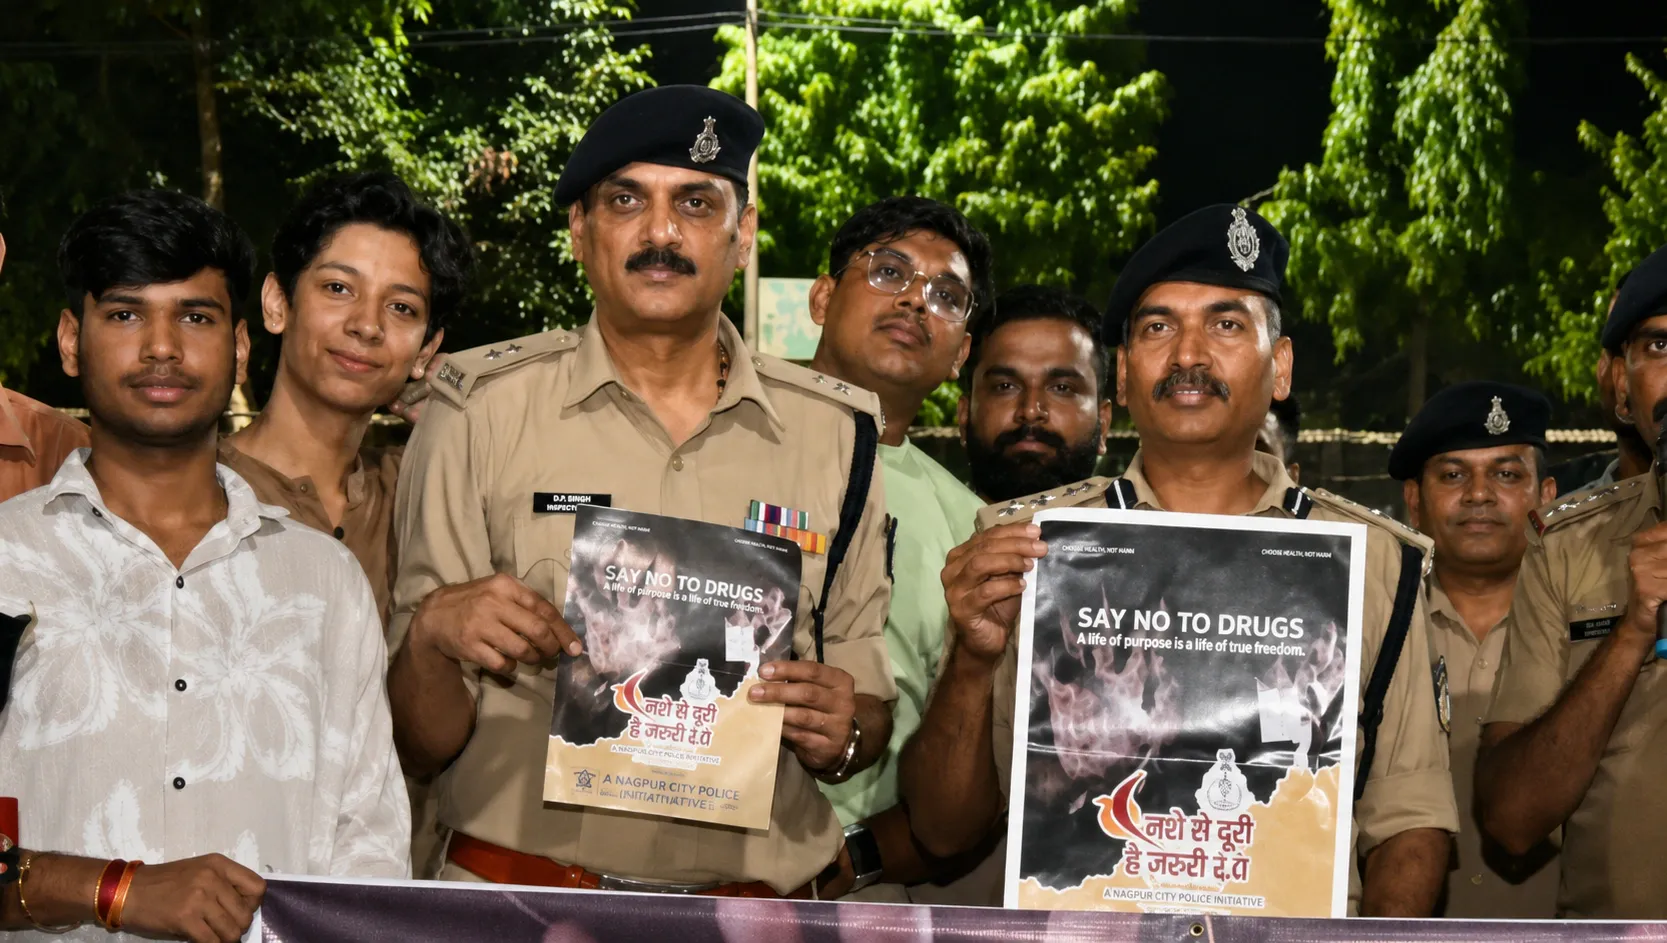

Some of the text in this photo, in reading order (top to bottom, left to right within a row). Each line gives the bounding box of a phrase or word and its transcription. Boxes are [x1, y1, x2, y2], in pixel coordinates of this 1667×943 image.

[605, 565, 763, 603] SAY NO TO DRUGS
[611, 583, 625, 593] life
[627, 585, 636, 594] of
[638, 587, 671, 599] purpose
[673, 591, 680, 600] is
[689, 593, 701, 604] life
[703, 597, 712, 605] of
[713, 598, 729, 608] true
[1078, 607, 1304, 638] SAY NO TO DRUGS
[1077, 632, 1306, 656] A life of purpose is a life of true freedom.
[645, 696, 718, 727] नशे से दूरी
[630, 716, 641, 738] है
[602, 774, 740, 801] A NAGPUR CITY POLICE
[1145, 810, 1254, 852] नशे से दूरी
[1125, 842, 1142, 875] है
[1104, 889, 1263, 907] A NAGPUR CITY POLICE INITIATIVE
